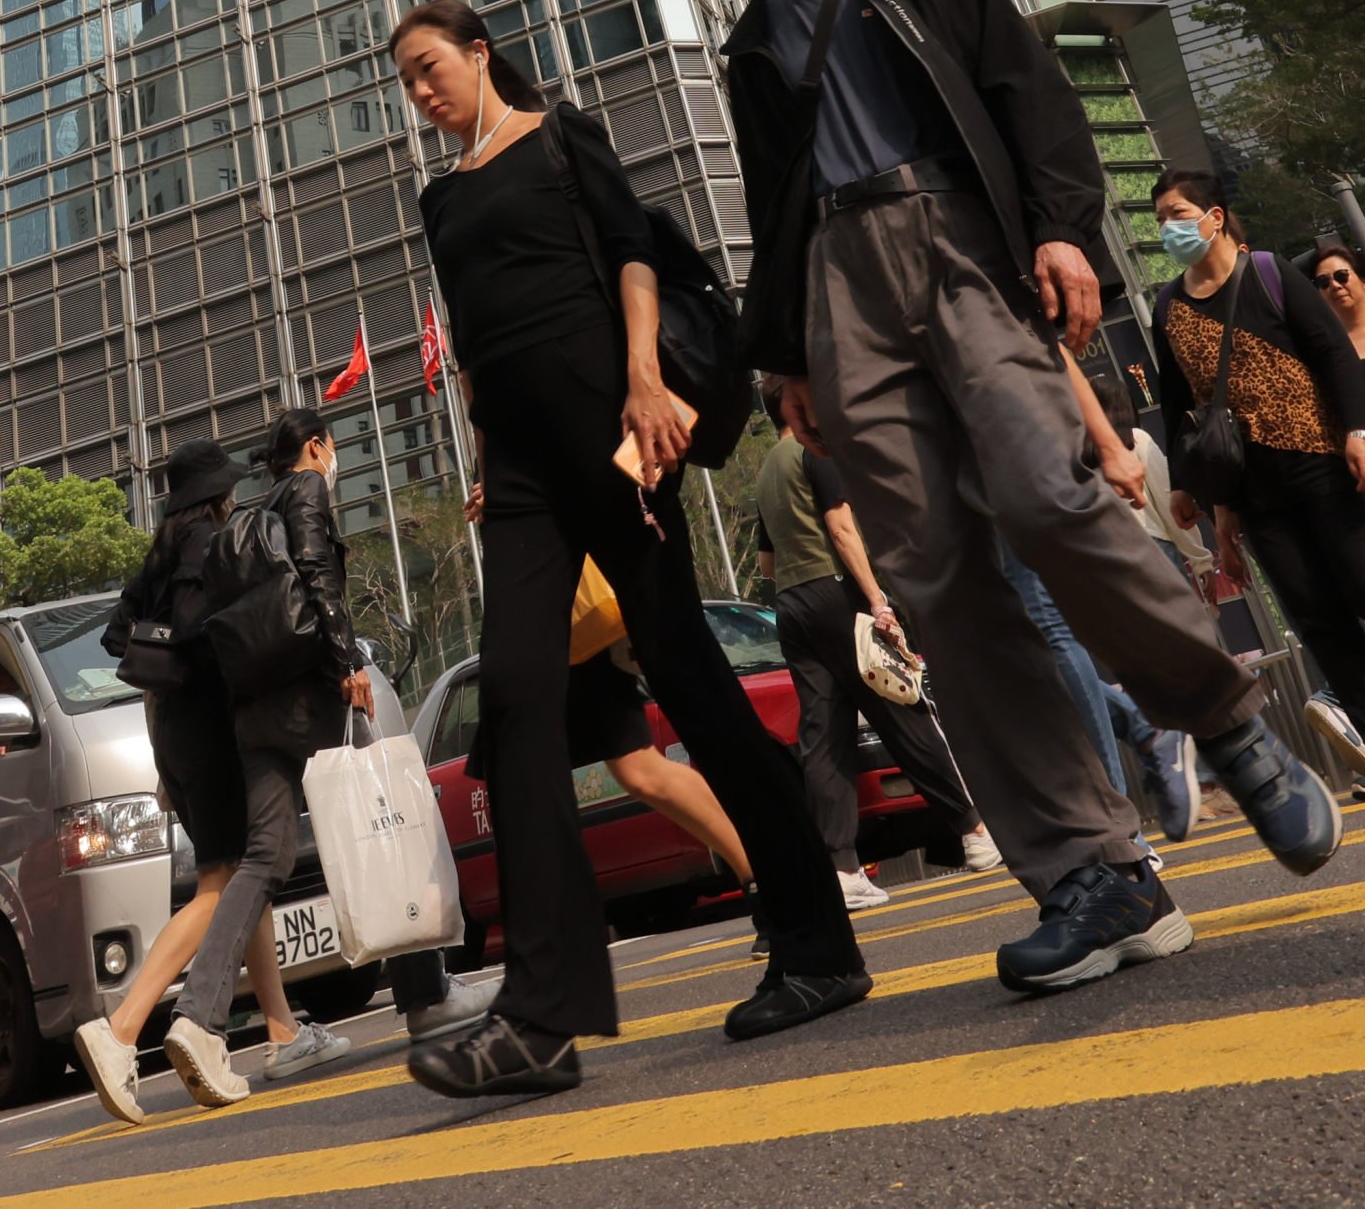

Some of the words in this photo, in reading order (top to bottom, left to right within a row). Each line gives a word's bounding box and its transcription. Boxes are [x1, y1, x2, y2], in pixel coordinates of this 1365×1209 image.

[471, 785, 489, 810] 的
[472, 809, 493, 836] TA
[283, 905, 316, 938] NN
